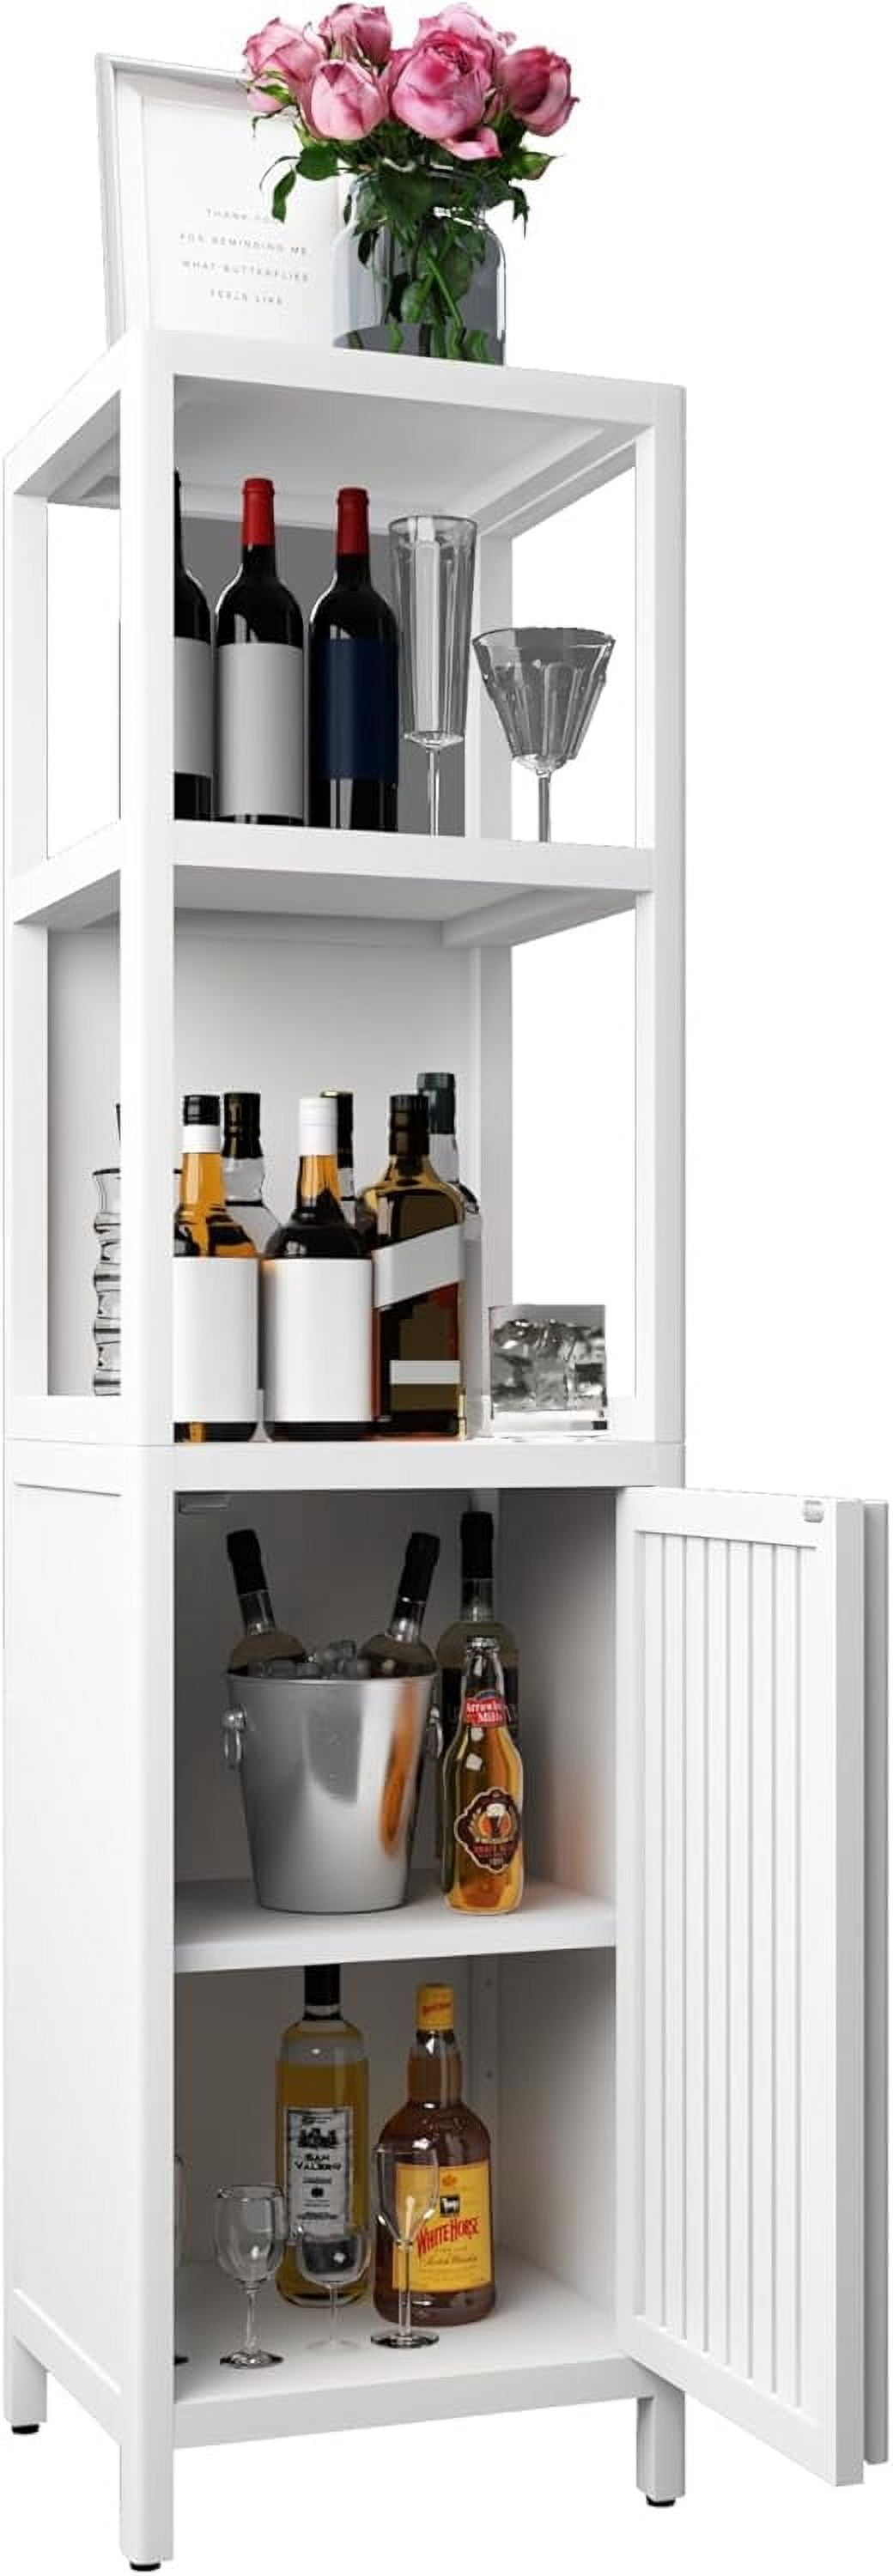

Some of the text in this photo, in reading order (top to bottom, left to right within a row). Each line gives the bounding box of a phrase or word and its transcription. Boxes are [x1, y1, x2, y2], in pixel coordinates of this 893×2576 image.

[179, 233, 307, 256] FOR REMINDING ME
[181, 260, 309, 283] WHAT BUTTERFLIES
